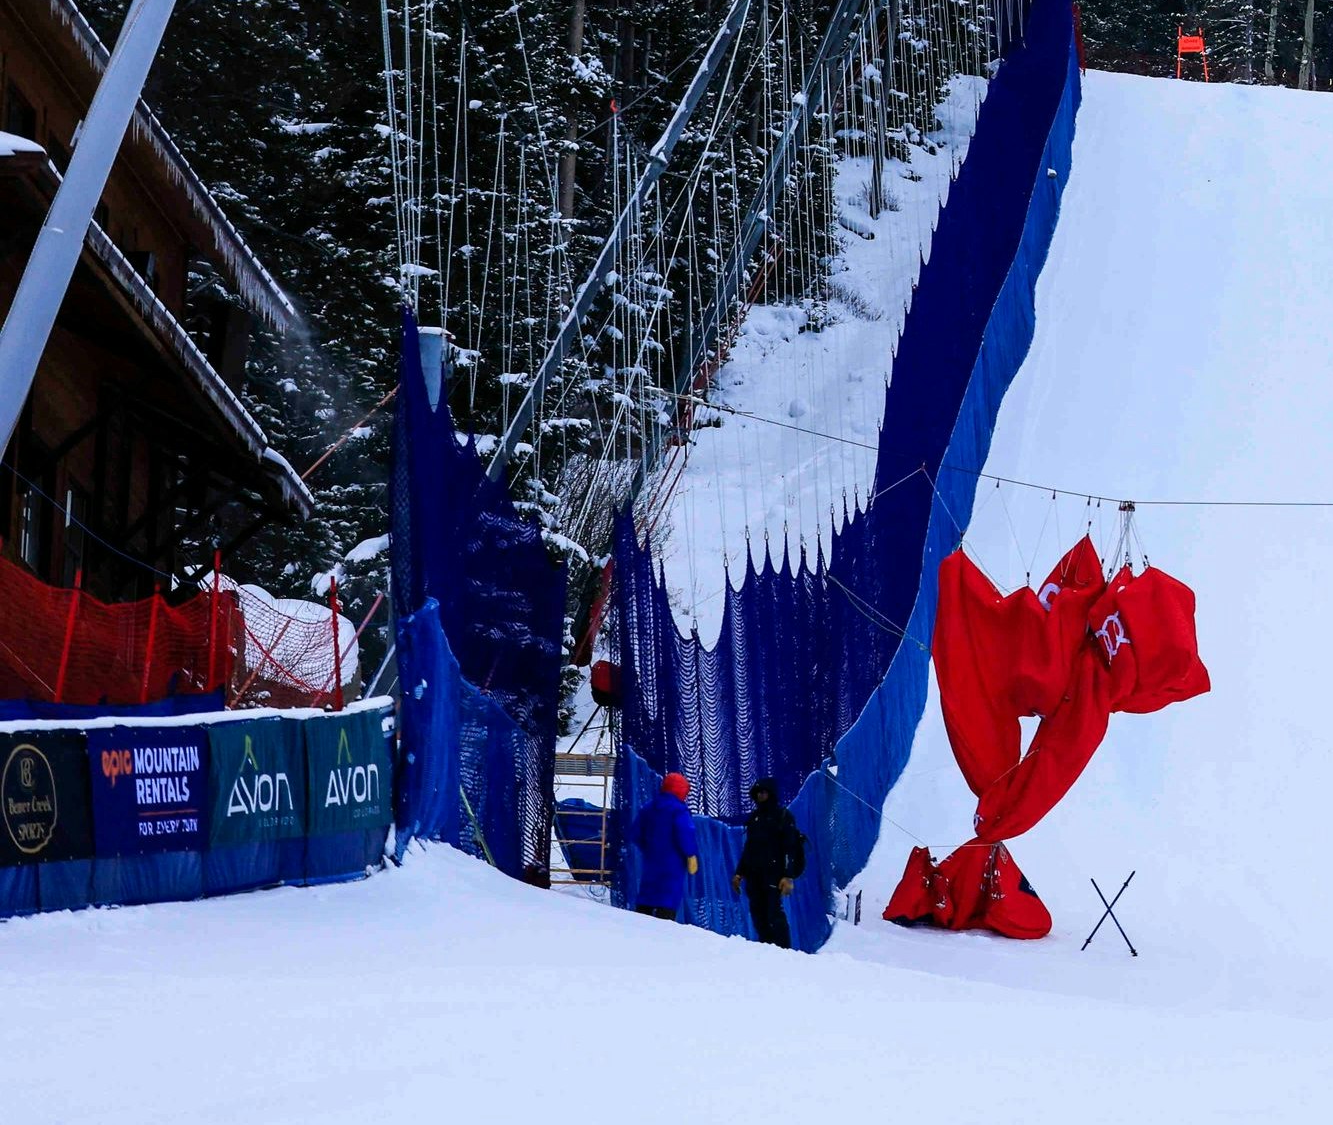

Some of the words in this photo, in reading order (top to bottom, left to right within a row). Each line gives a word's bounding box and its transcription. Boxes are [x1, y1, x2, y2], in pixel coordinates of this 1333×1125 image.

[133, 746, 200, 774] MOUNTAIN
[135, 776, 190, 805] RENTALS
[138, 821, 154, 836] FOR
